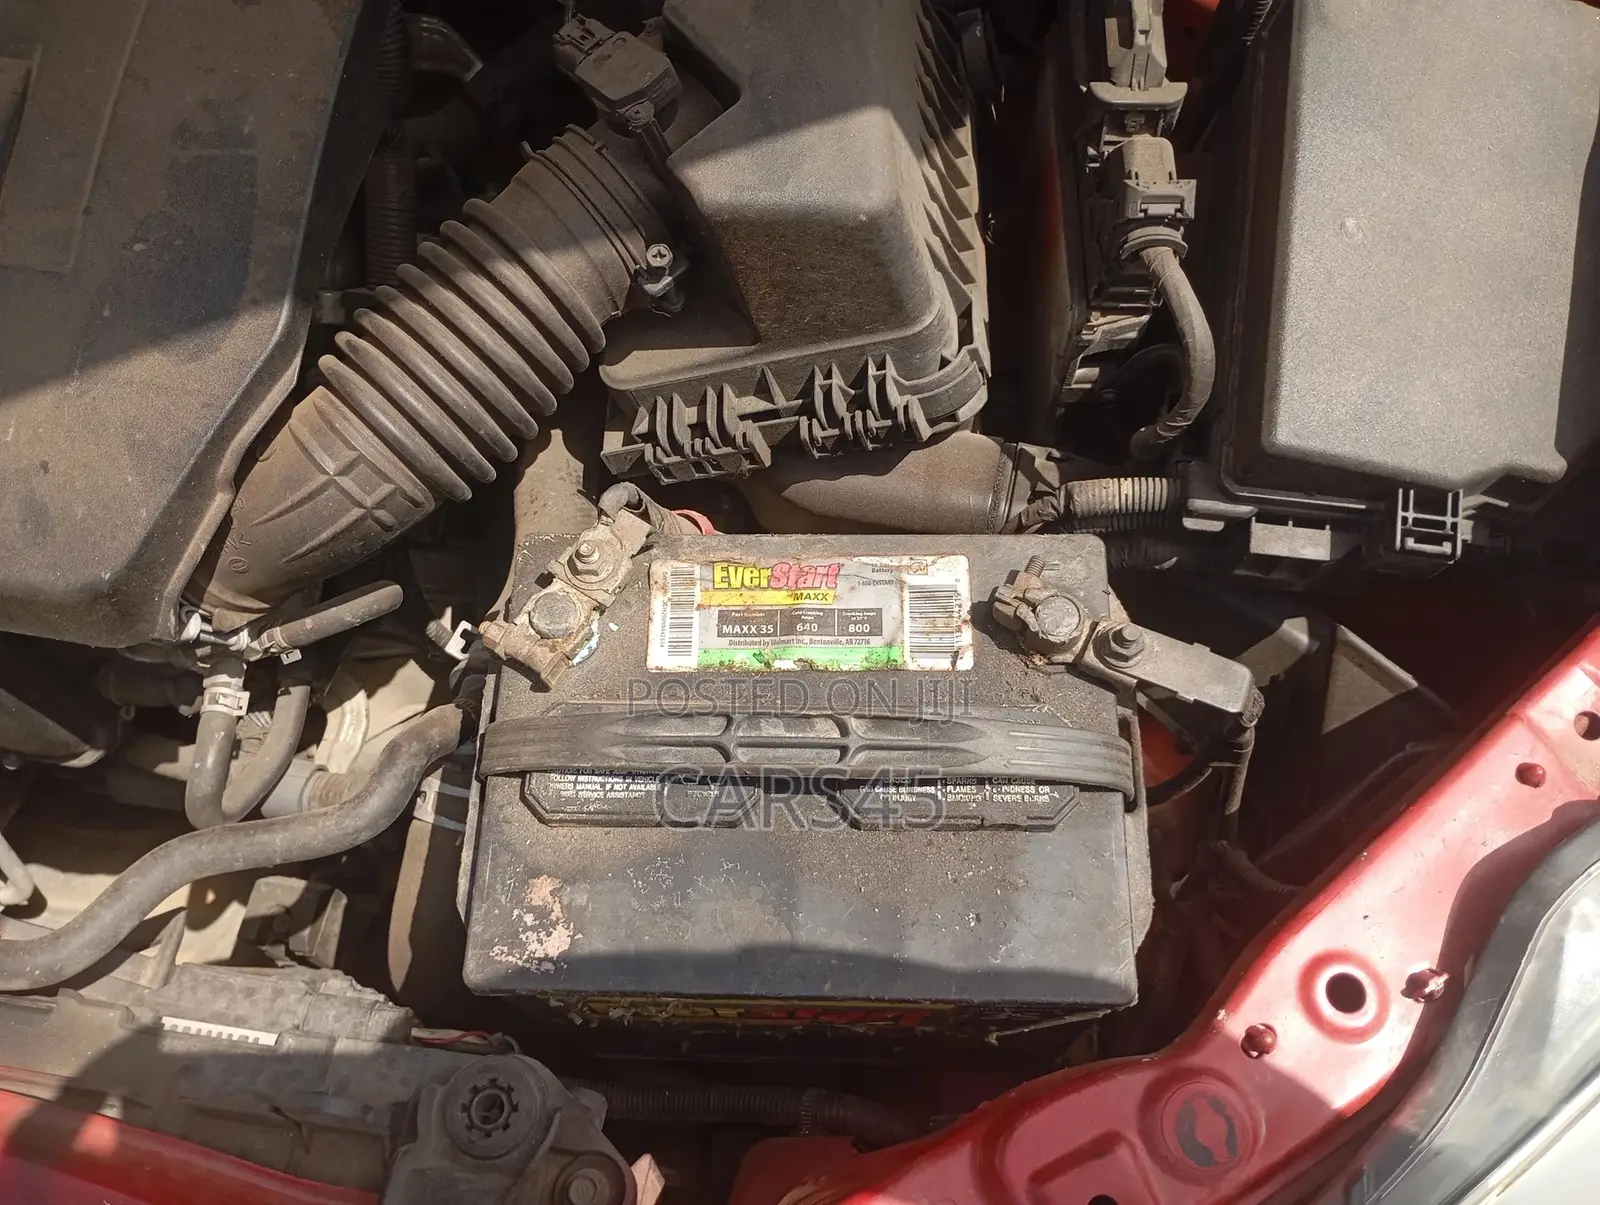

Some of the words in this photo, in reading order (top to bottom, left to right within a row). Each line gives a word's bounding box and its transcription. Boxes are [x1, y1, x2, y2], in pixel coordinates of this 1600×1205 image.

[713, 561, 840, 590] EverStart
[793, 592, 829, 602] MAXX
[722, 624, 758, 634] MAXX
[760, 624, 774, 634] 35
[796, 622, 819, 632] 640
[848, 623, 871, 633] 800
[728, 639, 762, 647] Distributed
[763, 639, 770, 648] by
[770, 637, 795, 646] Walmart
[845, 638, 854, 646] AR
[549, 774, 577, 782] FOLLOW
[577, 775, 624, 783] INSTRUCTIONS
[946, 777, 977, 785] SPARKS
[605, 783, 612, 791] IF
[613, 783, 628, 791] NOT
[874, 785, 897, 794] CAUSE
[898, 785, 936, 794] BLINDNESS
[946, 785, 977, 793] FLAMES
[1038, 785, 1050, 794] OR
[577, 791, 605, 799] SERVICE
[892, 793, 917, 802] INJURY
[946, 794, 982, 802] SMOKING
[992, 794, 1022, 802] SEVERE
[1024, 794, 1051, 803] BURNS
